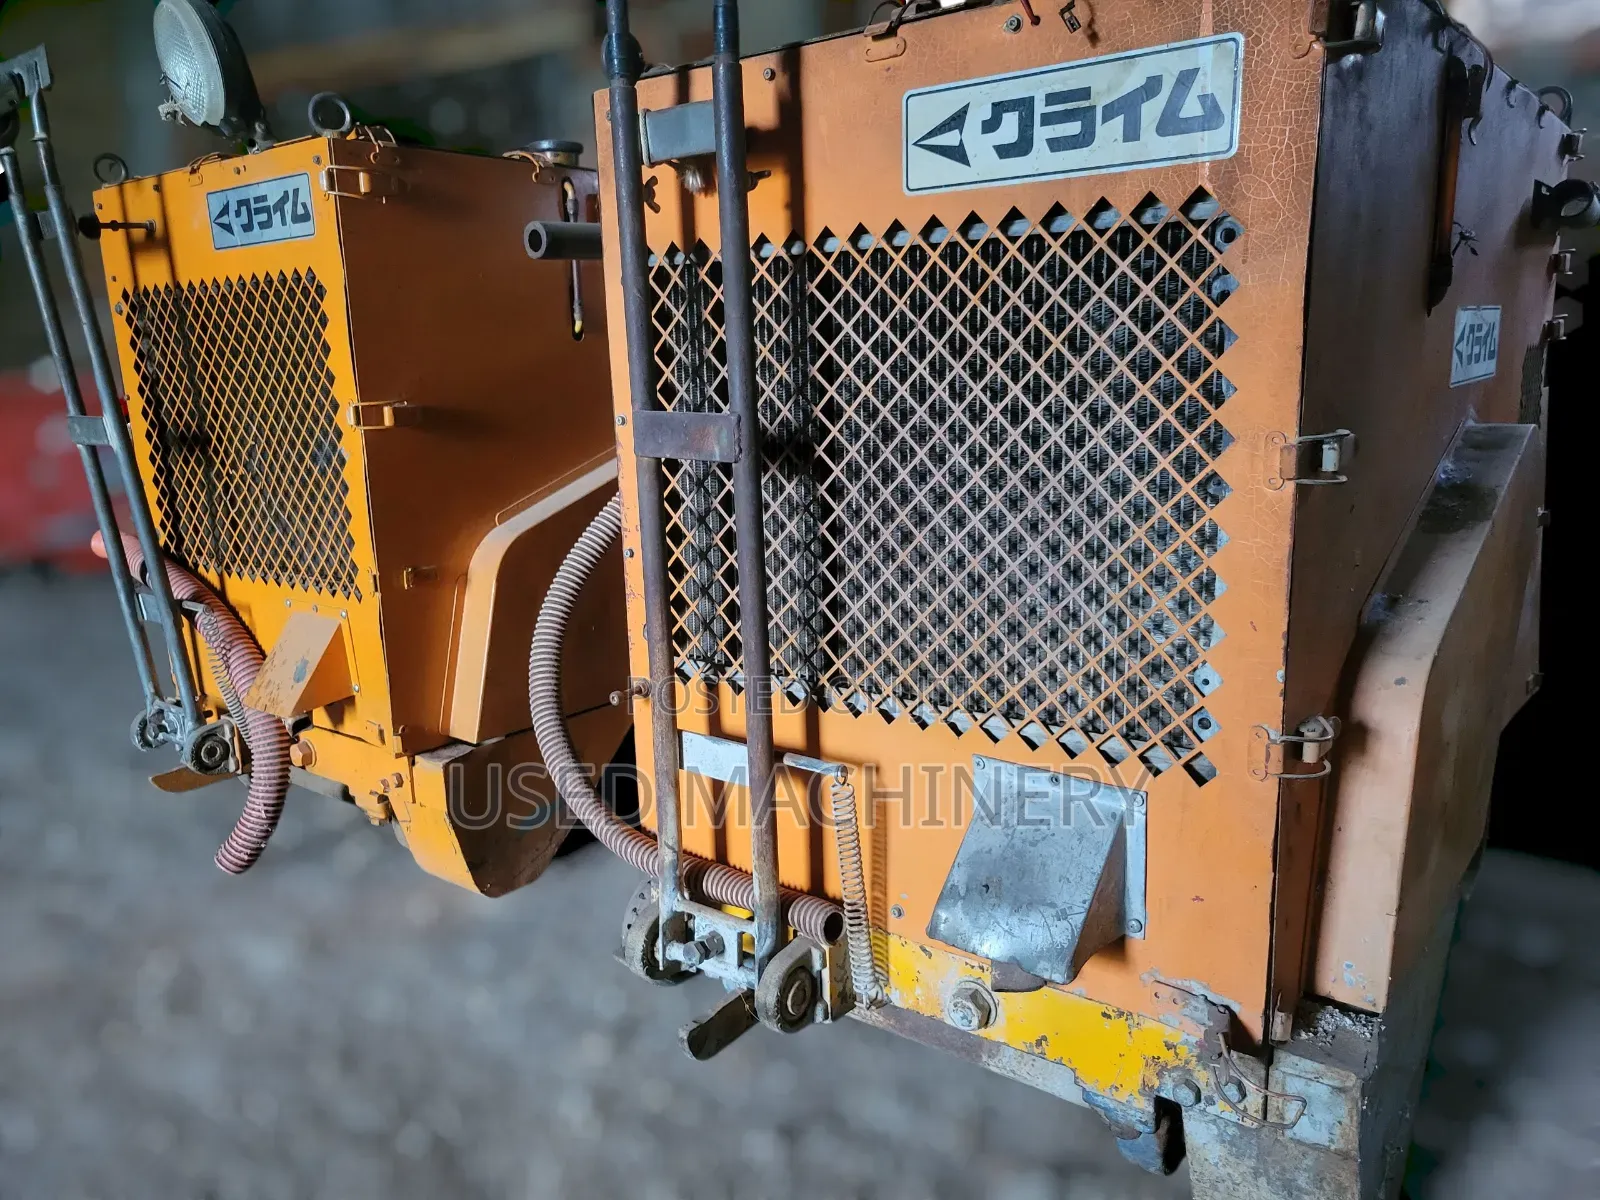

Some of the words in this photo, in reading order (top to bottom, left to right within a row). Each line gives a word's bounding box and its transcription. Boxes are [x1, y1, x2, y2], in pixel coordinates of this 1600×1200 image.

[980, 67, 1225, 160] クライム
[235, 188, 311, 233] クライム
[1465, 321, 1497, 366] クライム
